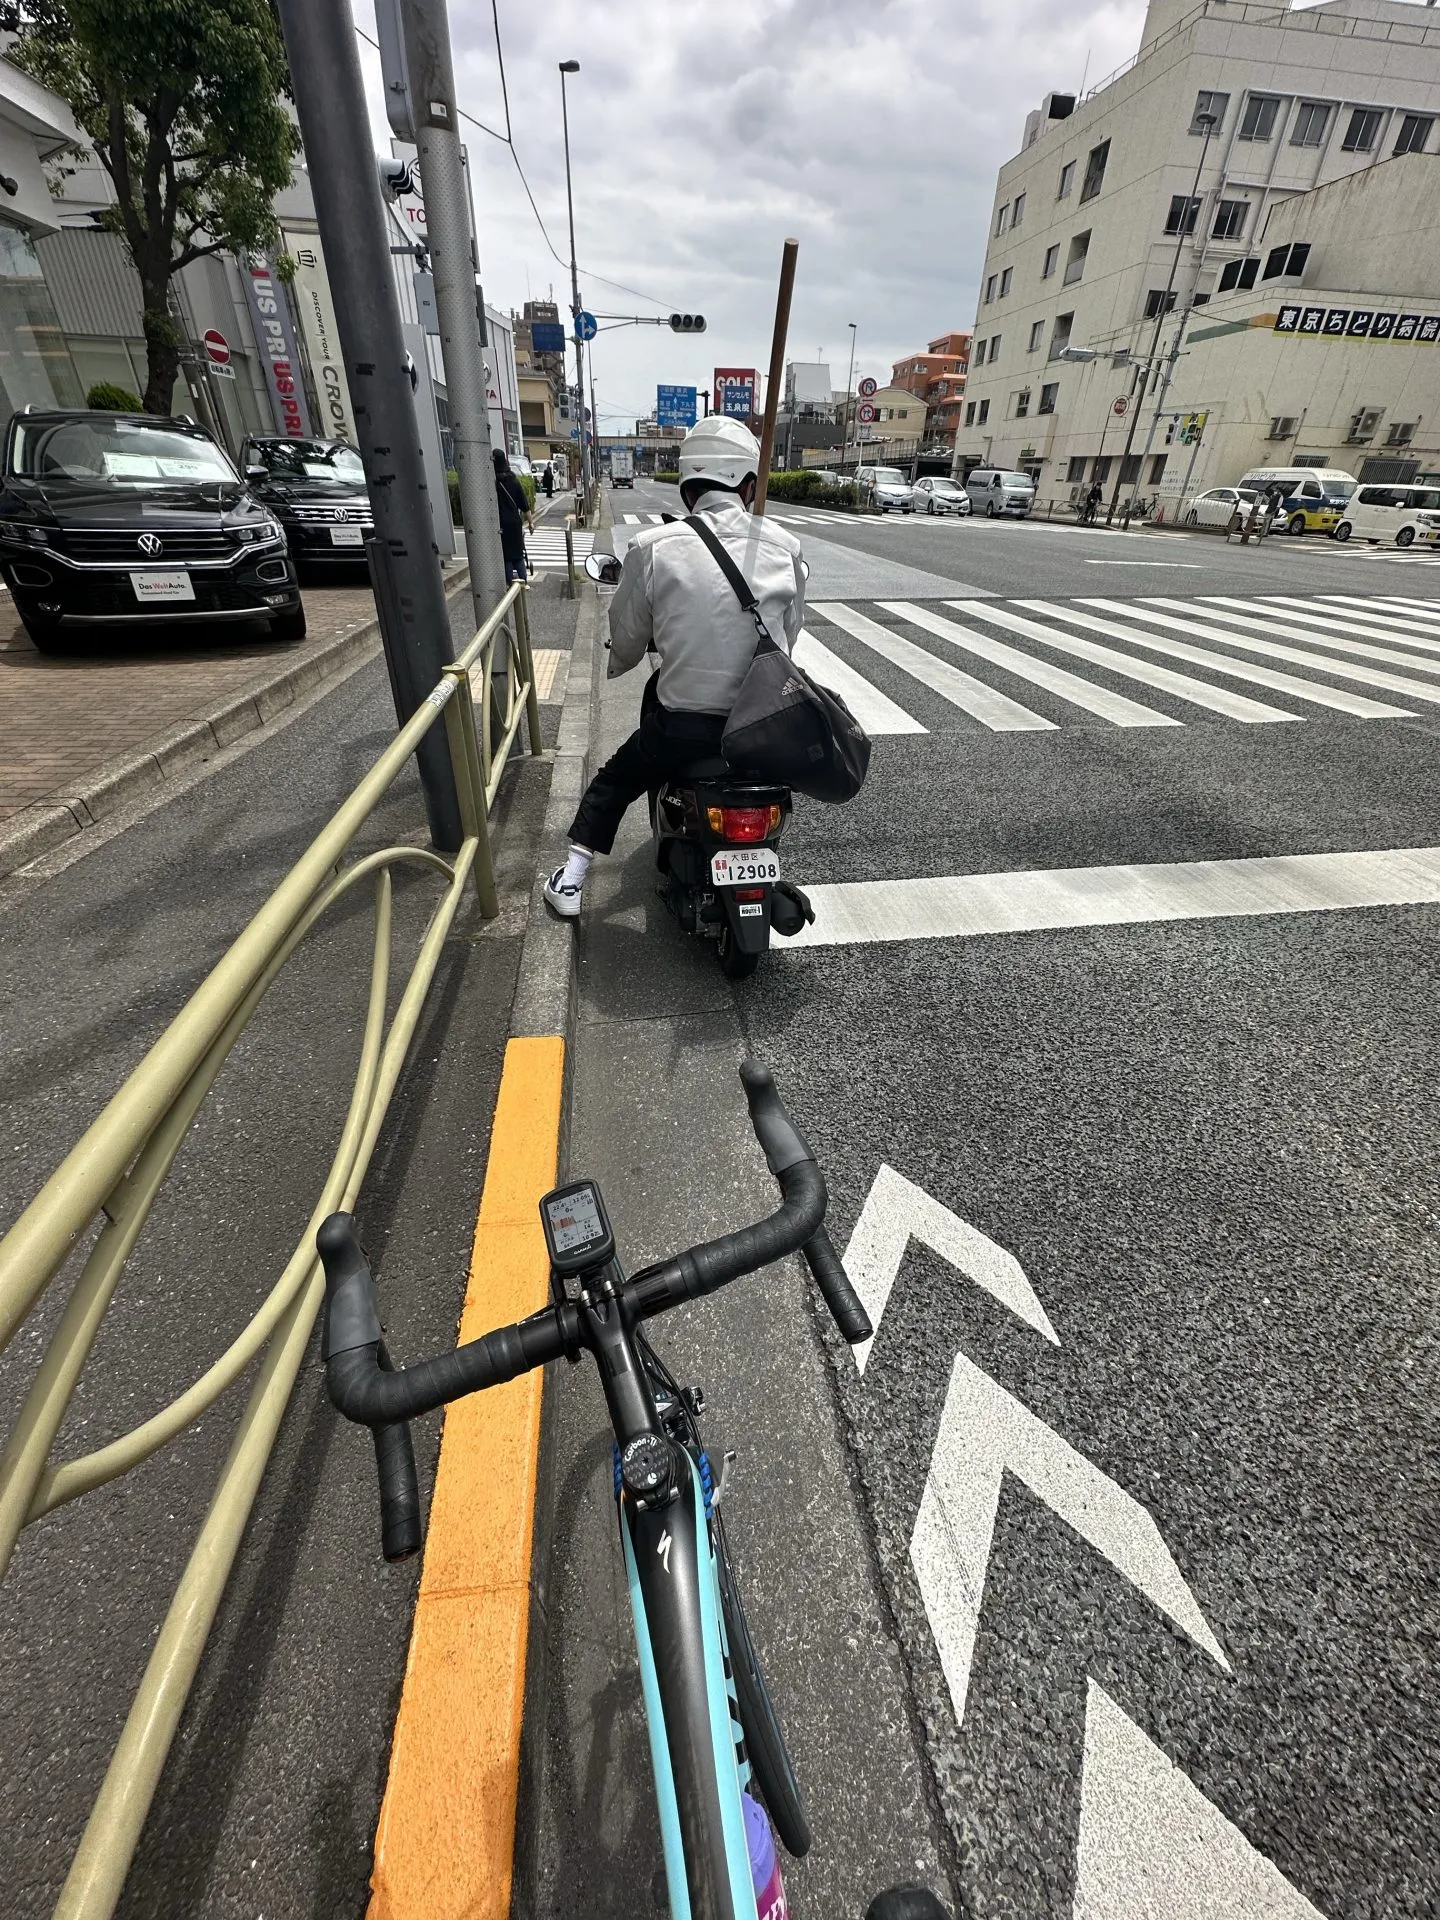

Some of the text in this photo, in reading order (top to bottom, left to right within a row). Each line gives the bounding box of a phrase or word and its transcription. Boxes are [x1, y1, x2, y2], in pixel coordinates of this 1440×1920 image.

[312, 291, 330, 360] DISCOVER YOUR
[1279, 309, 1438, 339] 東京ちどり病院
[263, 320, 295, 394] PRIUS
[716, 376, 753, 391] GOLF
[727, 391, 750, 399] サンセルモ
[725, 403, 750, 412] 玉泉院
[665, 795, 682, 807] JOG
[731, 852, 759, 862] 大田区
[716, 872, 725, 882] い
[728, 863, 777, 881] 12908
